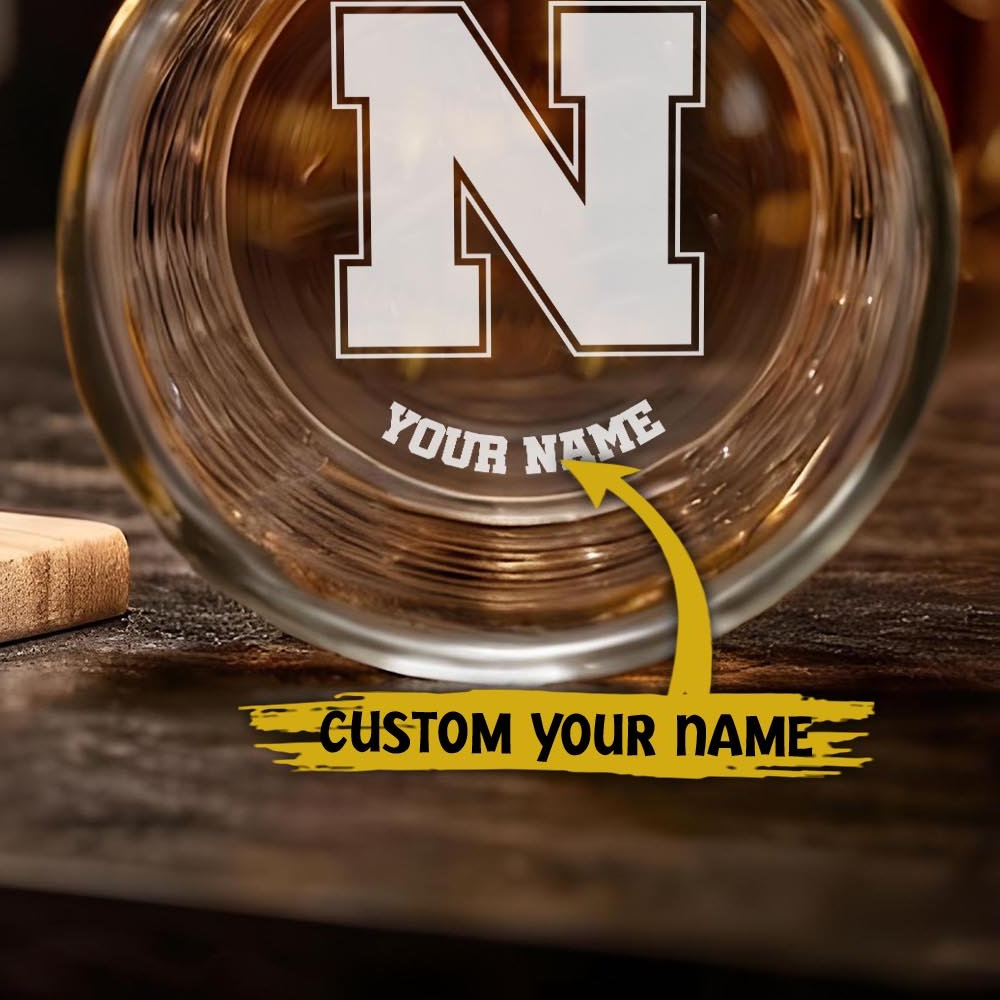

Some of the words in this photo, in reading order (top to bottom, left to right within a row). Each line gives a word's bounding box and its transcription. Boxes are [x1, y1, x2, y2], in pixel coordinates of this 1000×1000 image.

[330, 1, 706, 359] N
[381, 401, 508, 475] YOUR
[522, 399, 666, 475] NAME
